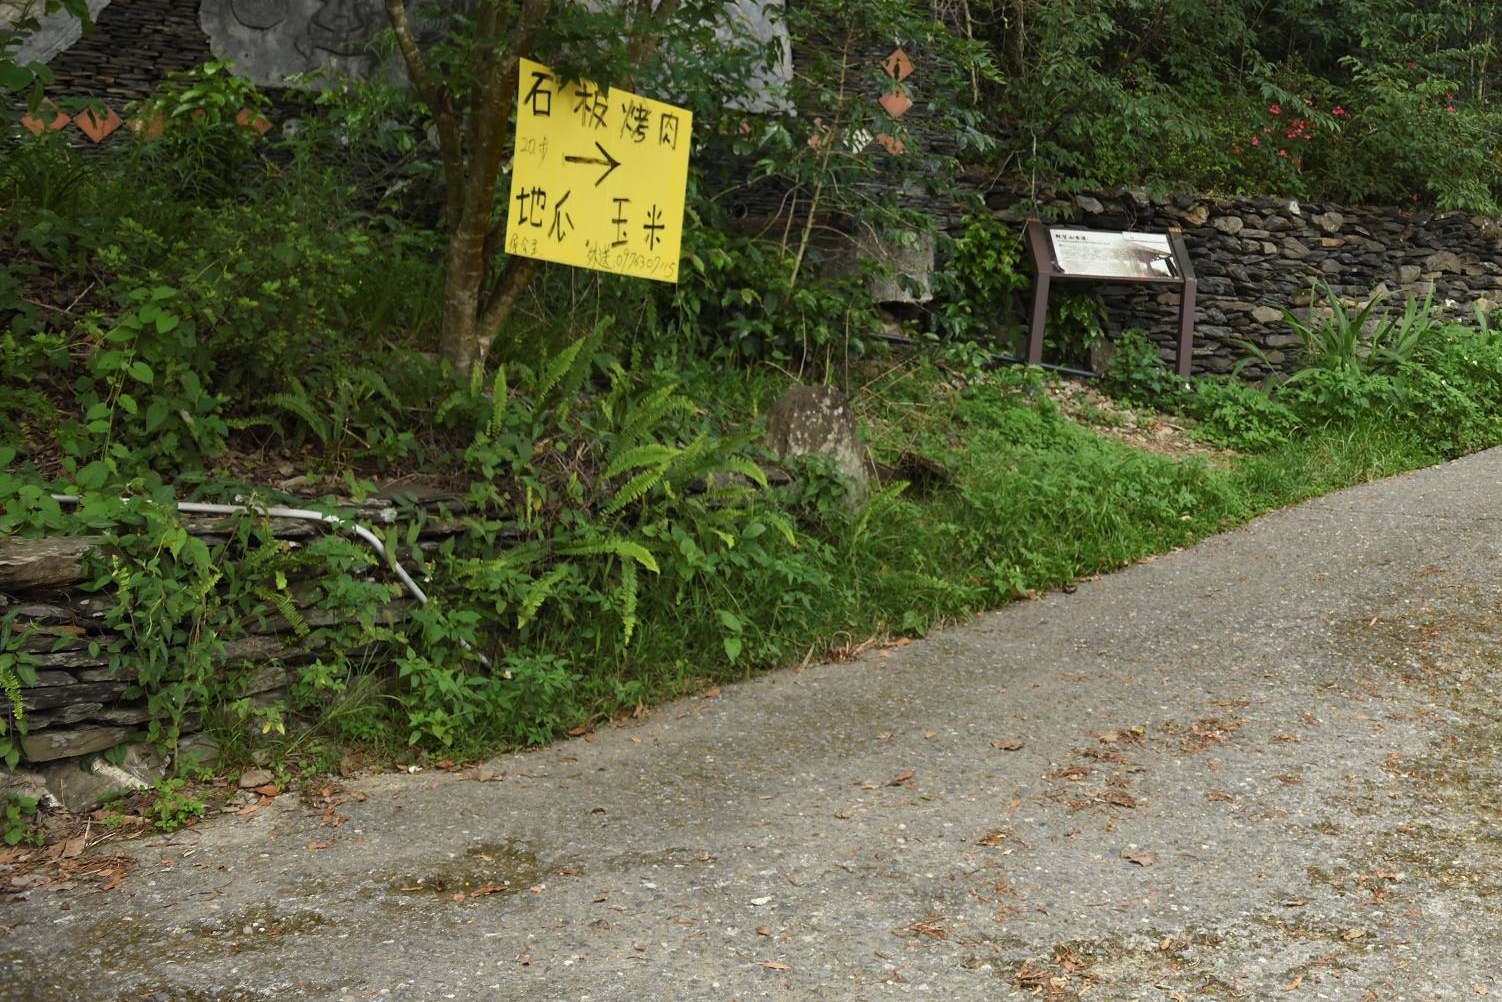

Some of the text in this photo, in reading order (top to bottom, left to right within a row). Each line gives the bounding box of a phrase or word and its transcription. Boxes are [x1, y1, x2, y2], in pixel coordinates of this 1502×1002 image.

[523, 71, 678, 150] 石板烤肉
[516, 187, 665, 250] 地瓜 玉米
